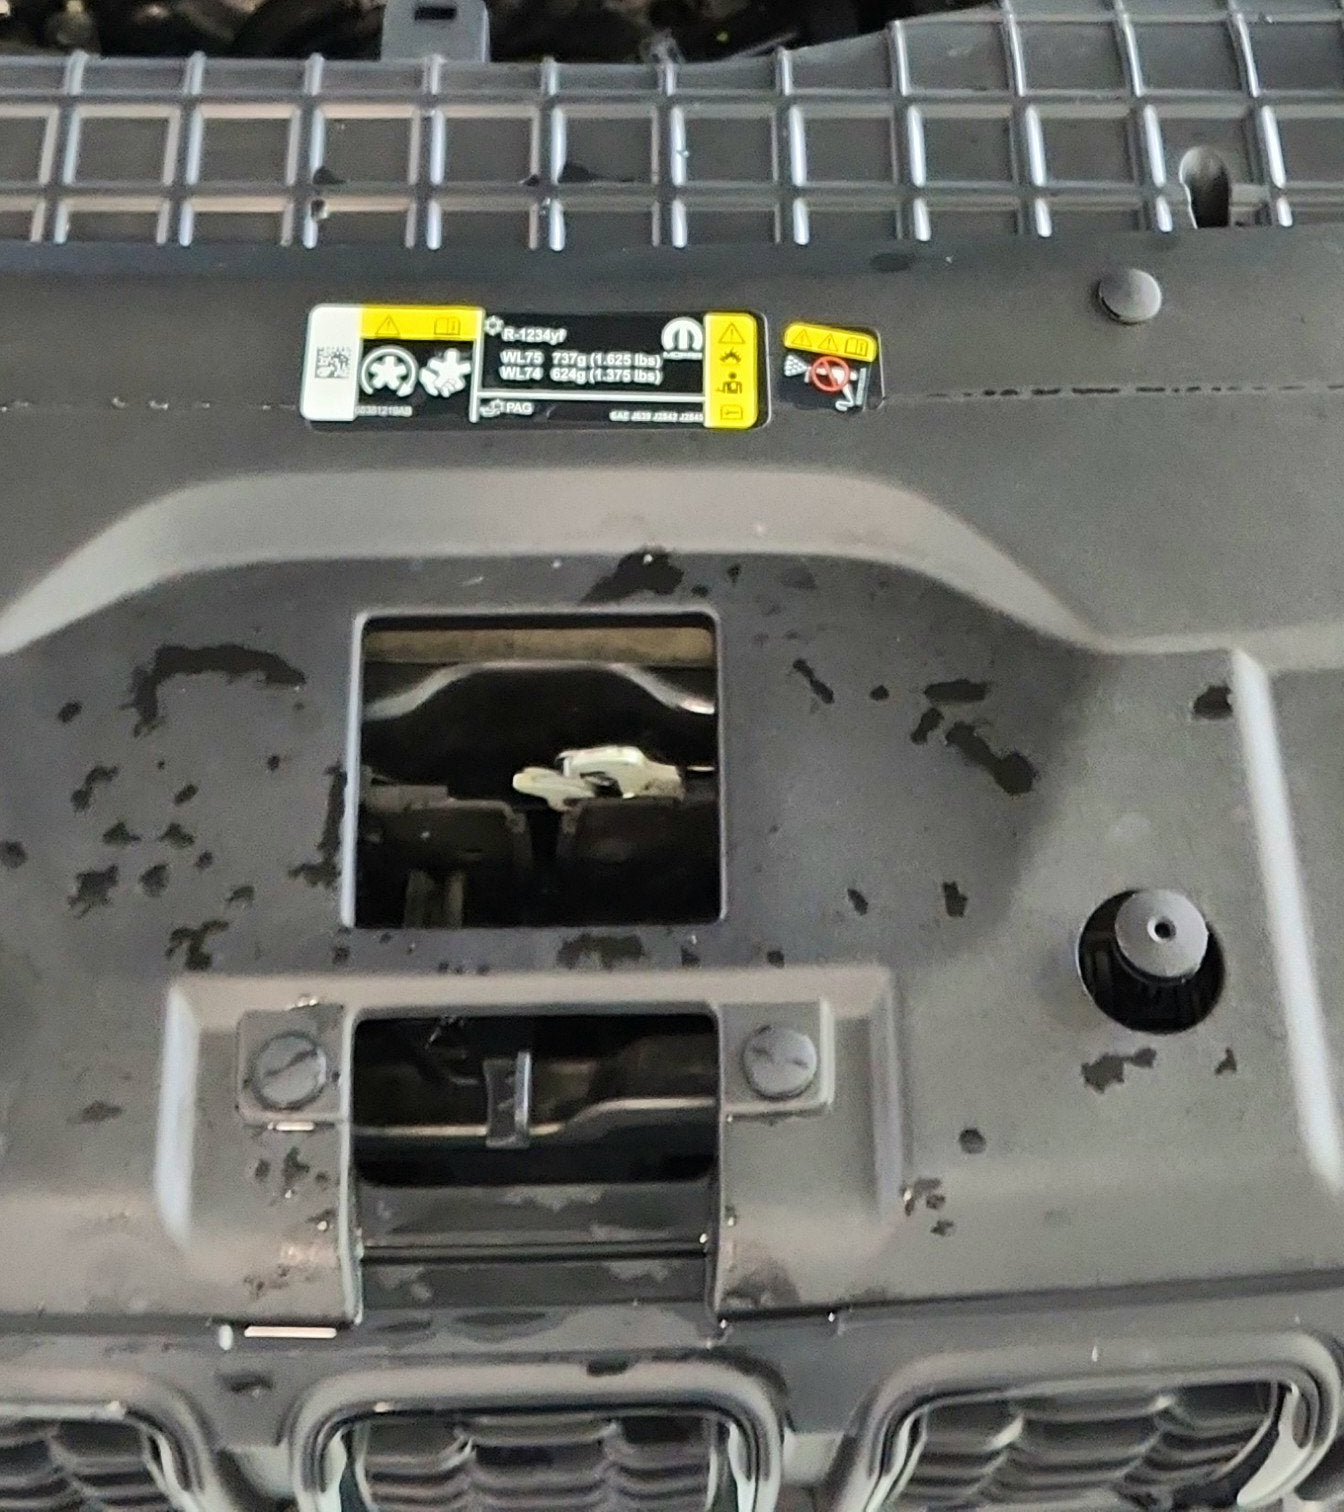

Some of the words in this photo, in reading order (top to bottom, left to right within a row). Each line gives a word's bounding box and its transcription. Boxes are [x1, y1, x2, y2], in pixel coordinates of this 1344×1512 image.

[503, 326, 567, 345] R-1234yf
[500, 350, 544, 365] WL75
[552, 350, 587, 368] 737g
[590, 352, 632, 368] (1.625
[634, 353, 663, 368] lbs)
[499, 365, 543, 381] WL74
[550, 366, 587, 384] 624g
[589, 367, 632, 384] (1.375
[634, 368, 663, 385] lbs)
[506, 402, 534, 416] PAG
